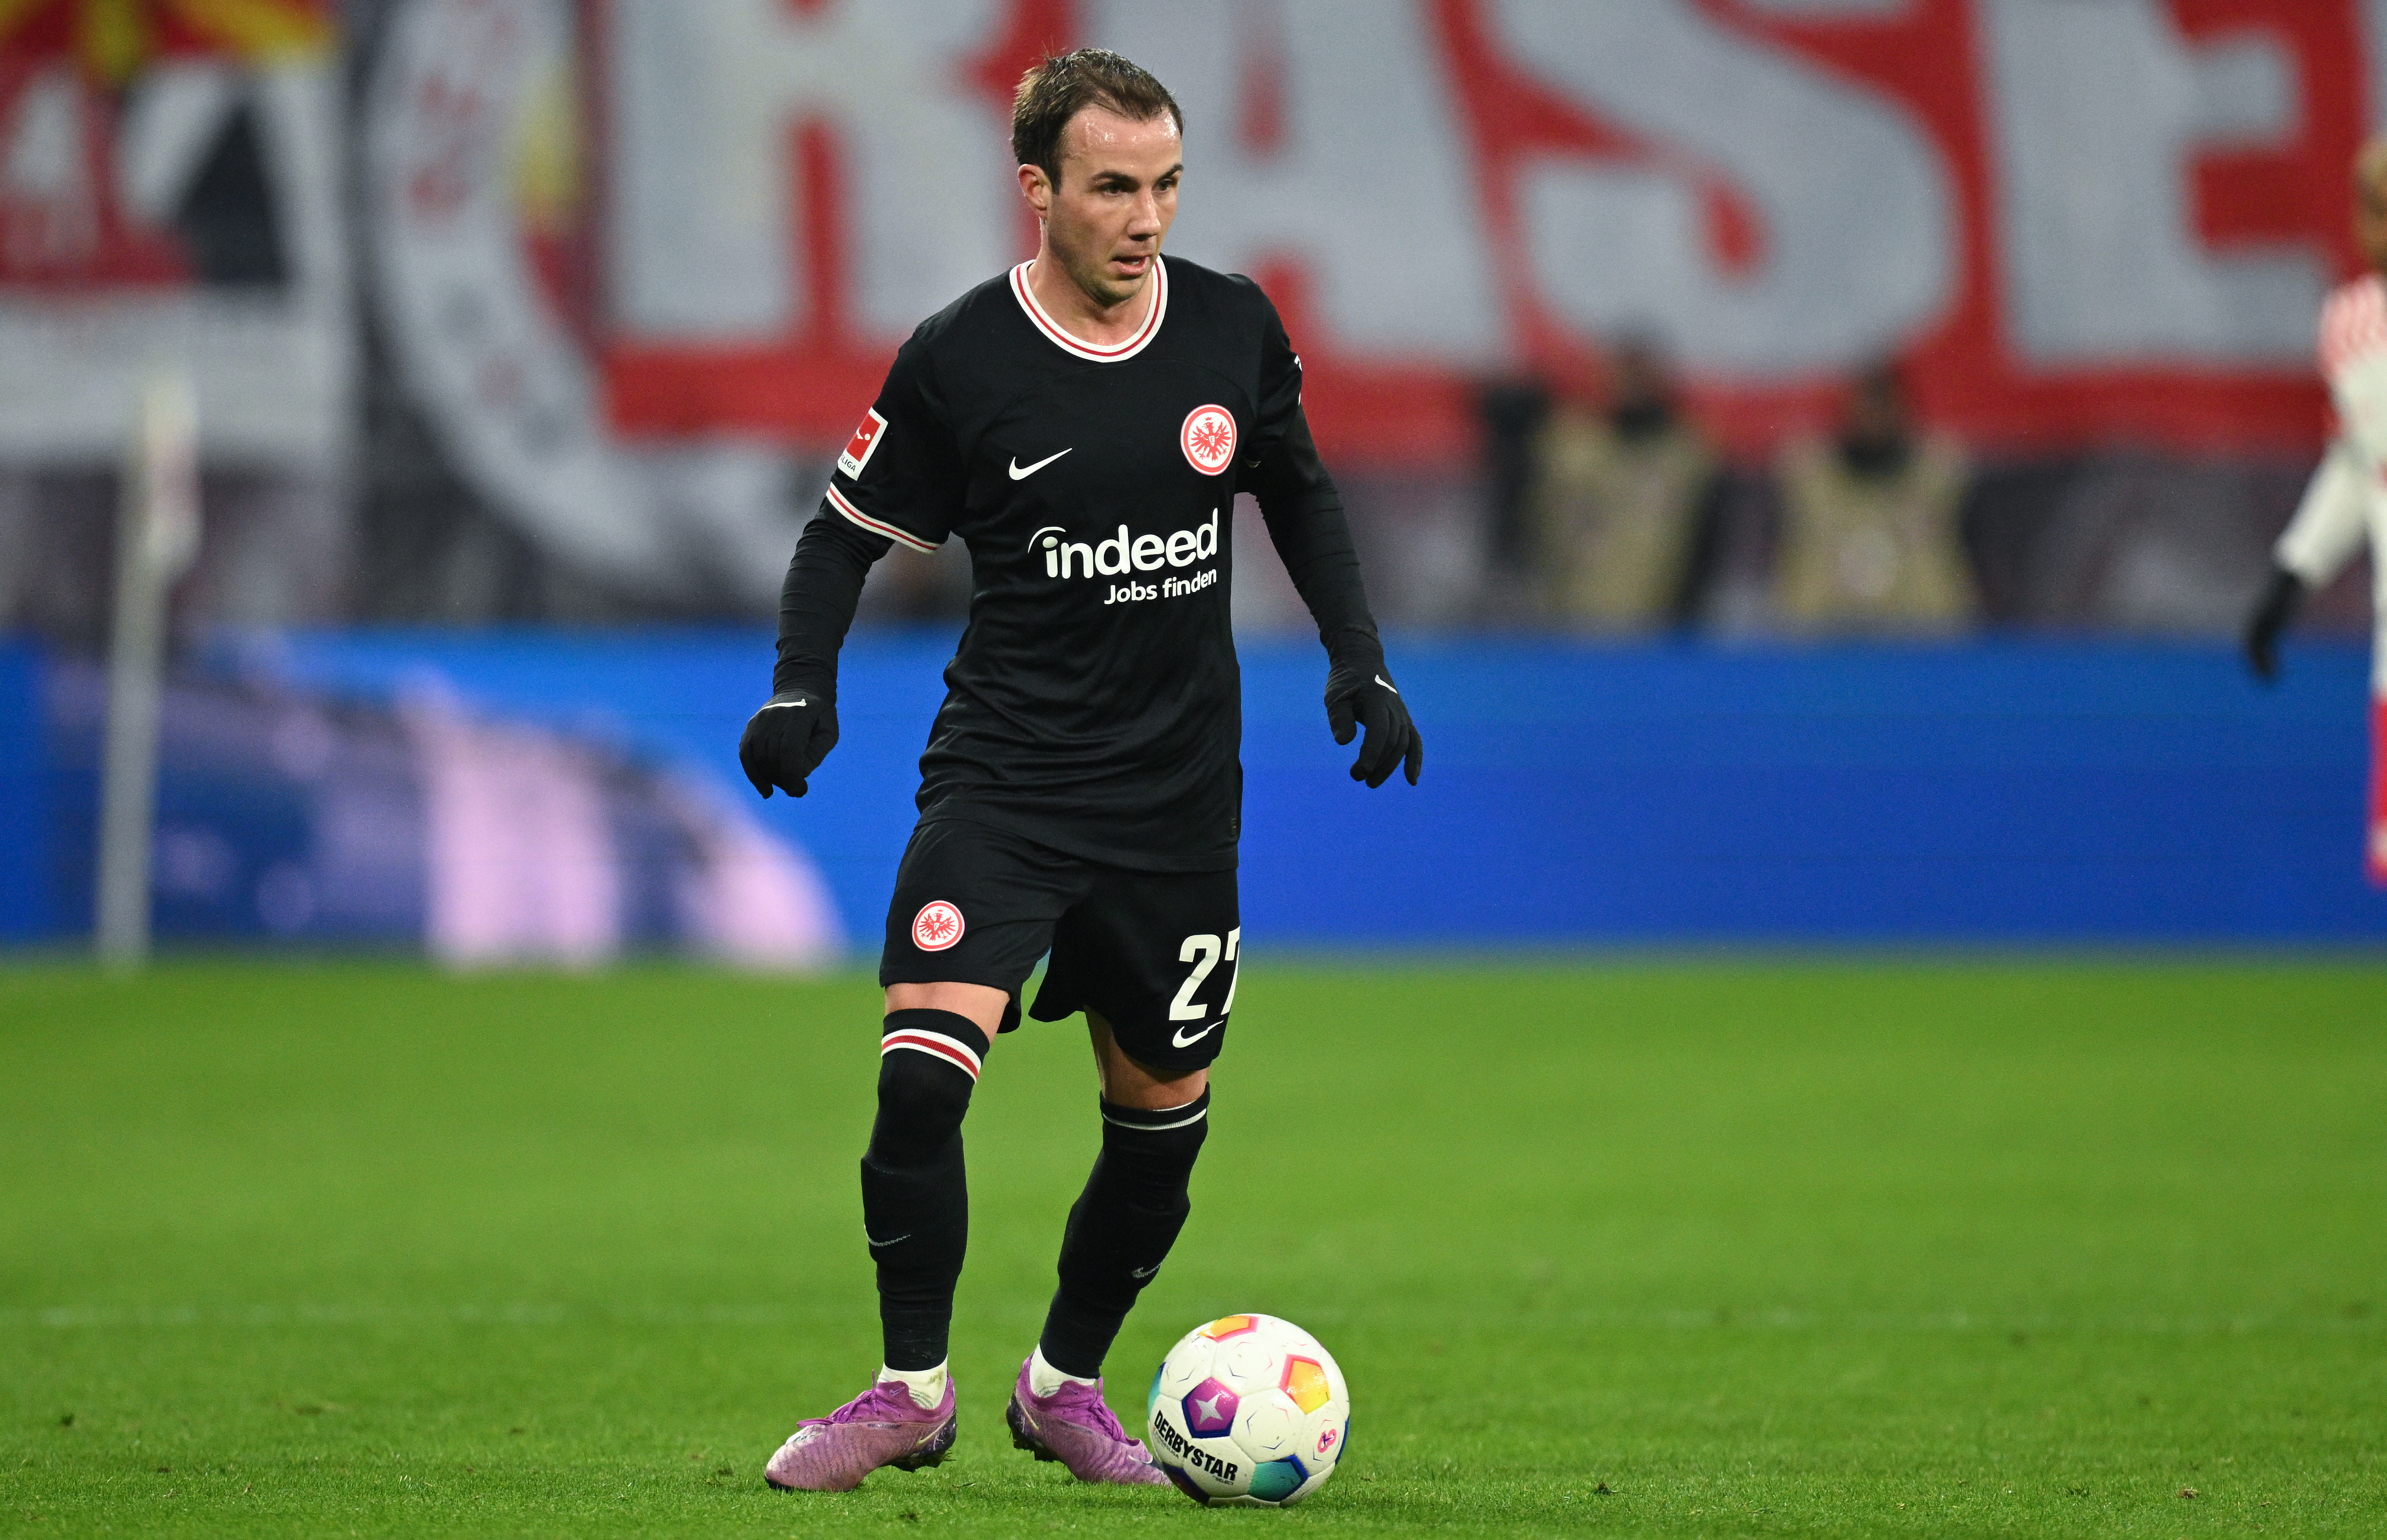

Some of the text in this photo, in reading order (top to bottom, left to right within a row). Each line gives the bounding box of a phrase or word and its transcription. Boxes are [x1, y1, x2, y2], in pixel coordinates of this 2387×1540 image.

[606, 0, 2387, 375] RASE
[1028, 508, 1218, 579] indeed
[1104, 569, 1217, 605] Jobs finden
[1169, 926, 1240, 1020] 27
[1154, 1410, 1238, 1481] DERBYSTAR
